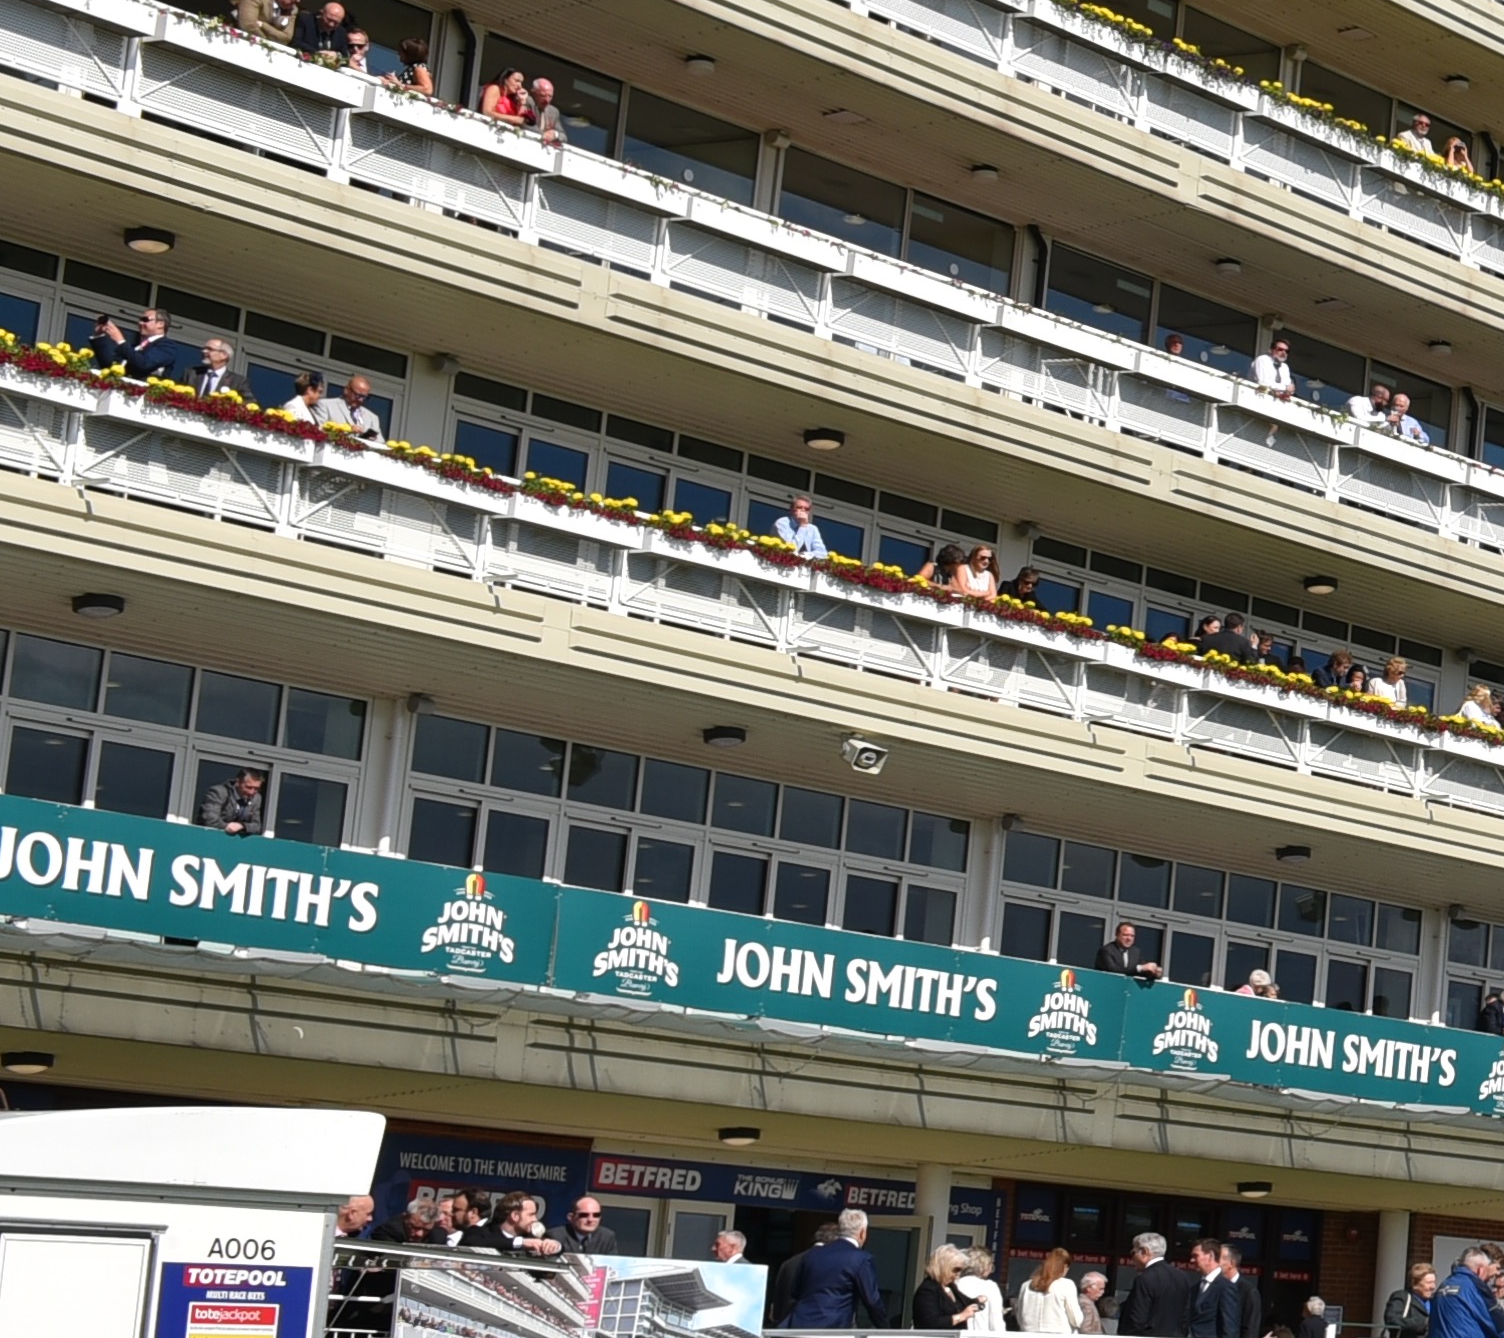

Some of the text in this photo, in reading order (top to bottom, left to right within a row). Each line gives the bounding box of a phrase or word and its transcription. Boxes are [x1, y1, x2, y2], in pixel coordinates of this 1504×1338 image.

[0, 826, 379, 932] JOHN SMITH'S
[437, 900, 503, 931] JOHN
[420, 923, 515, 964] SMITH'S
[608, 926, 668, 956] JOHN
[592, 947, 679, 988] SMITH'S
[717, 938, 997, 1021] JOHN SMITH'S
[1040, 992, 1090, 1018] JOHN
[1028, 1011, 1098, 1046] SMITH'S
[1164, 1011, 1211, 1035] JOHN
[1152, 1029, 1219, 1063] SMITH'S
[1246, 1019, 1457, 1087] JOHN SMITH'S
[400, 1151, 567, 1183] WELCOME TO THE KNAVESMIRE
[598, 1162, 702, 1192] BETFRED
[737, 1174, 784, 1185] THE BONUS
[733, 1180, 783, 1200] KING
[959, 1202, 983, 1217] Shop
[207, 1237, 276, 1261] A006
[188, 1268, 286, 1287] TOTEPOOL
[195, 1308, 261, 1323] totejackpot
